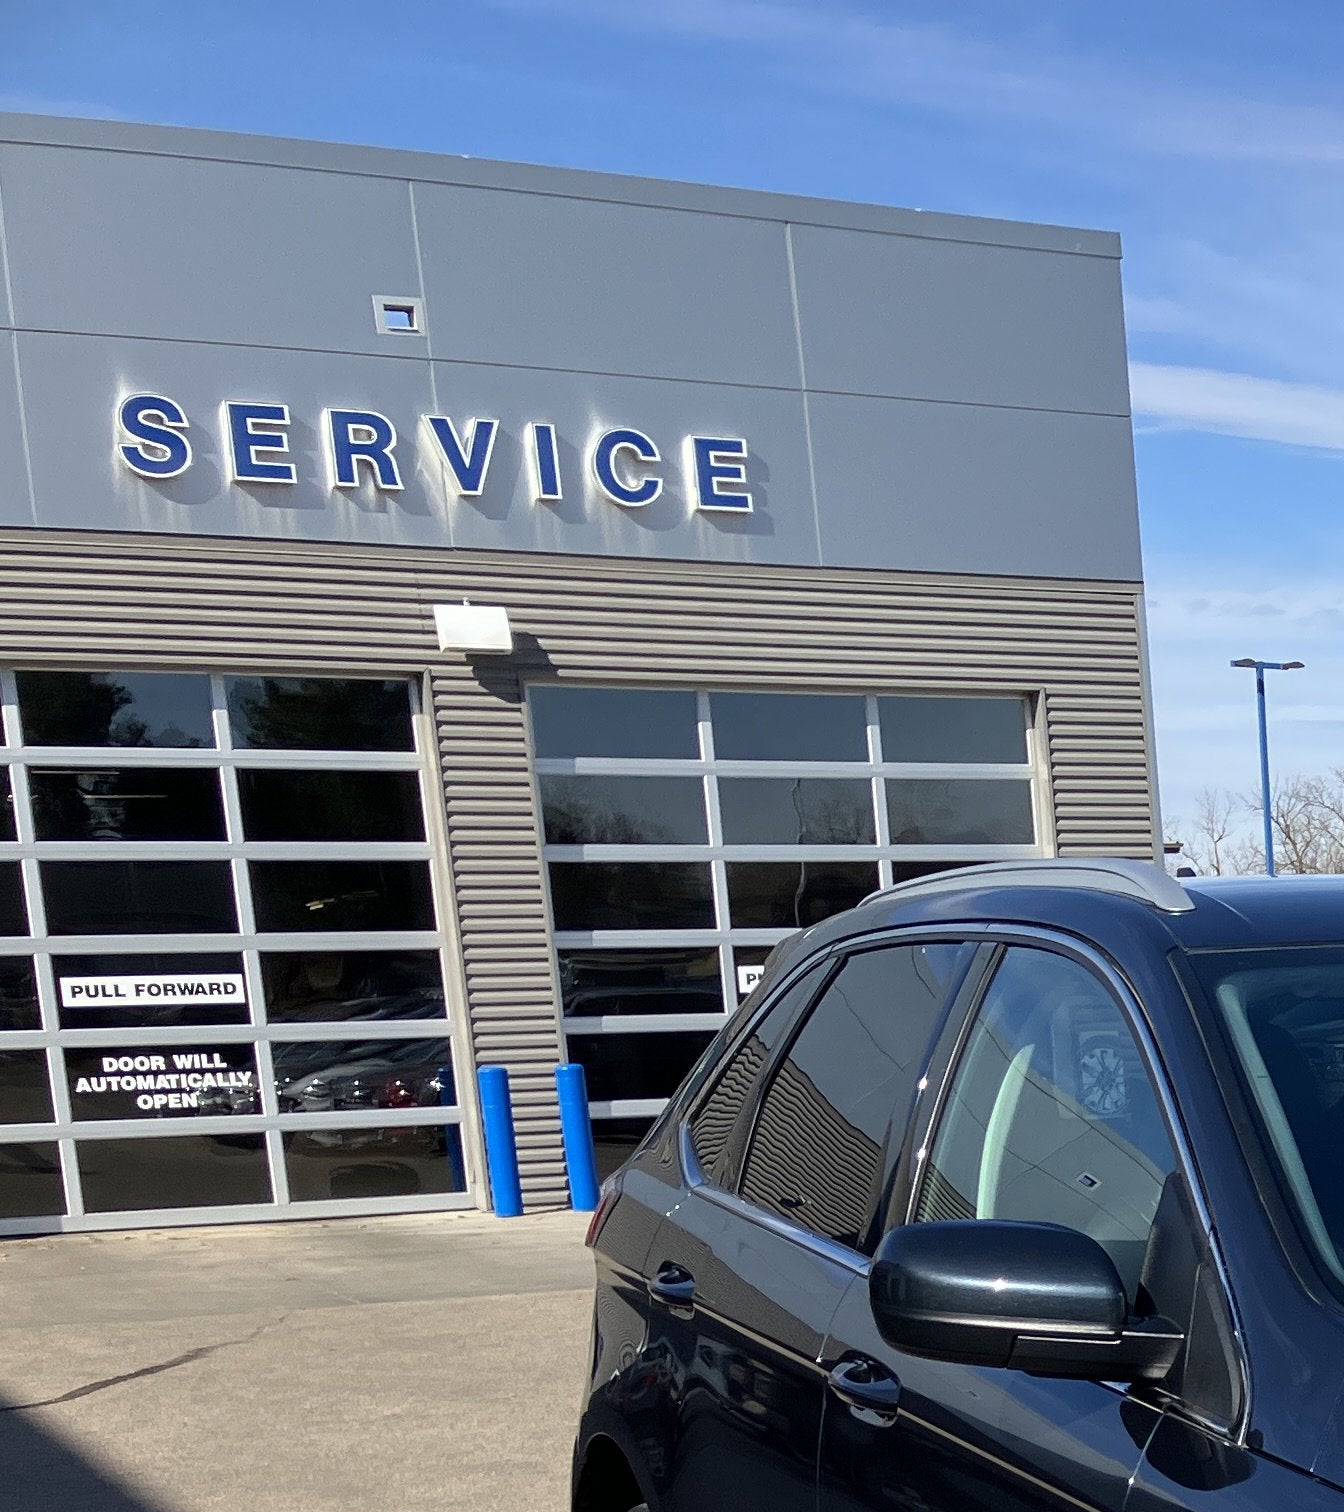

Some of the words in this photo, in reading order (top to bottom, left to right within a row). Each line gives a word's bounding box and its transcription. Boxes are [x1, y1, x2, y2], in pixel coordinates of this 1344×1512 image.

[116, 391, 755, 515] SERVICE
[71, 984, 126, 999] PULL
[135, 982, 237, 997] FORWARD
[102, 1056, 166, 1073] DOOR
[172, 1053, 227, 1069] WILL
[75, 1070, 252, 1093] AUTOMATICALLY
[136, 1093, 198, 1110] OPEN
